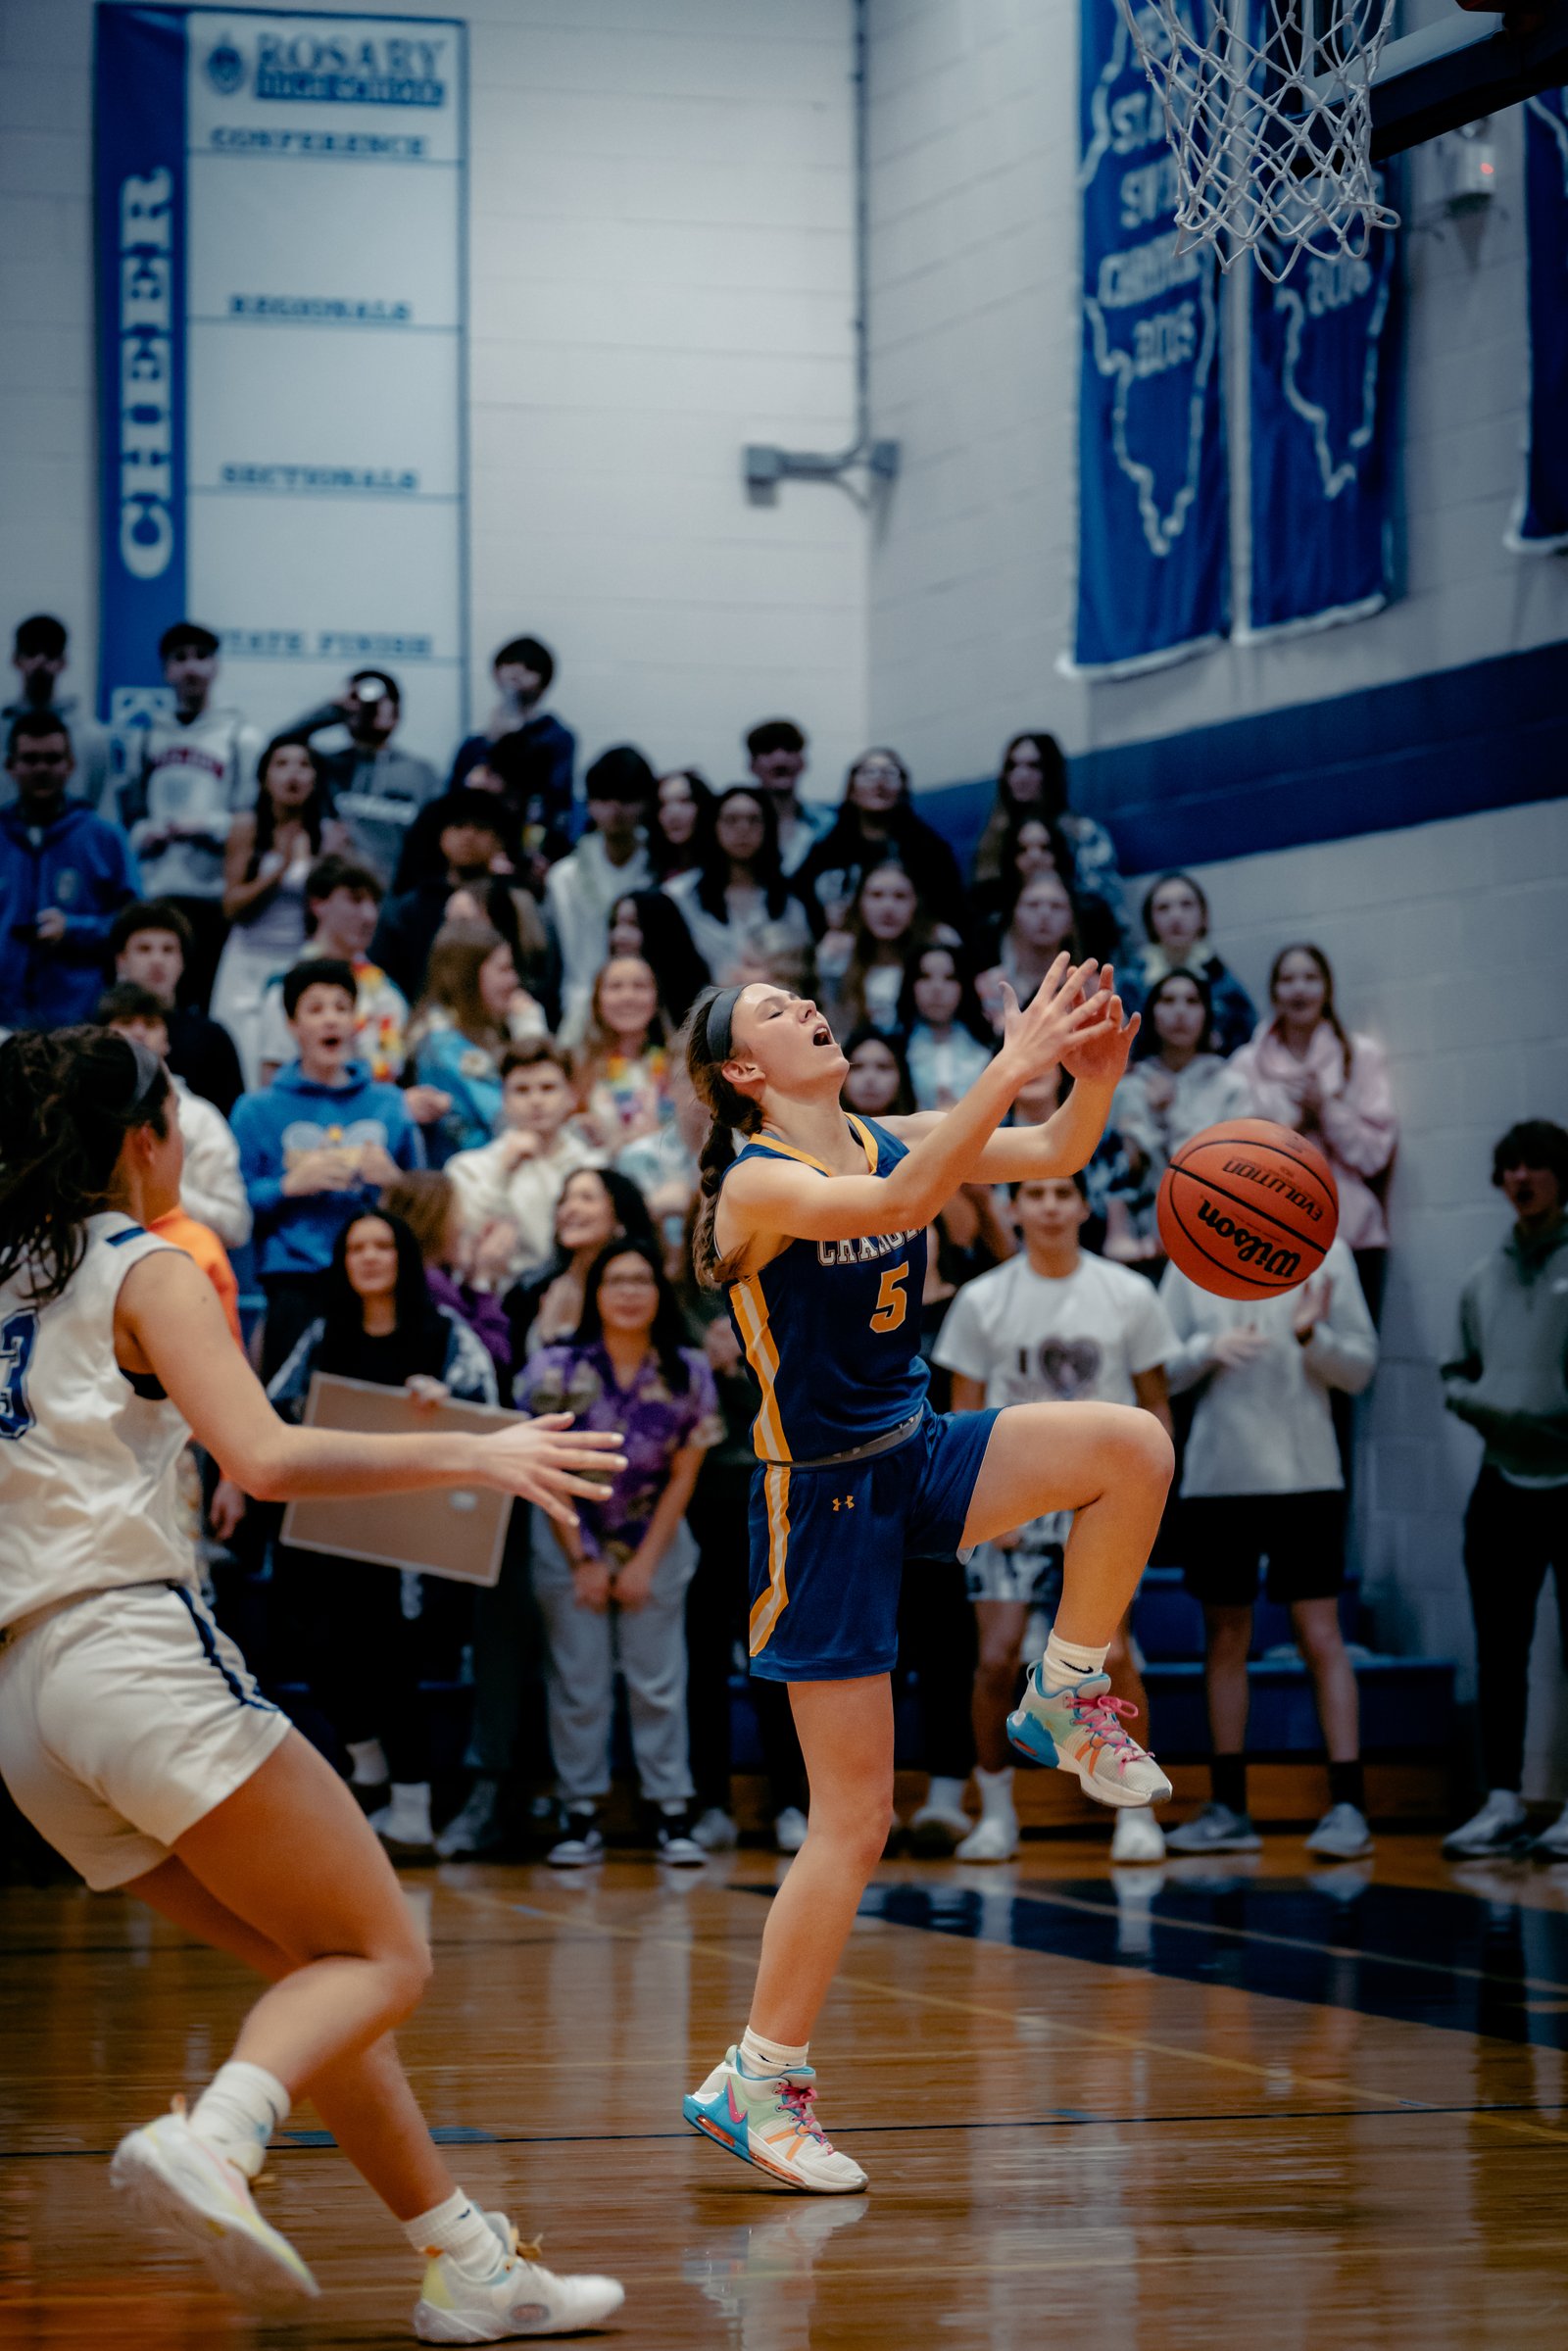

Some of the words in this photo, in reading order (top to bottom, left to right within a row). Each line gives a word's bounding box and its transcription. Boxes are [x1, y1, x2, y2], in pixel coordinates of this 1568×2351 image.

[258, 32, 447, 77] ROSARY
[212, 127, 425, 155] CONFERENCE
[120, 165, 174, 580] CHEER
[220, 629, 305, 655] TATE
[1222, 1160, 1323, 1222] EVOLUTION
[1198, 1200, 1301, 1278] Wilson
[869, 1260, 909, 1334] 5
